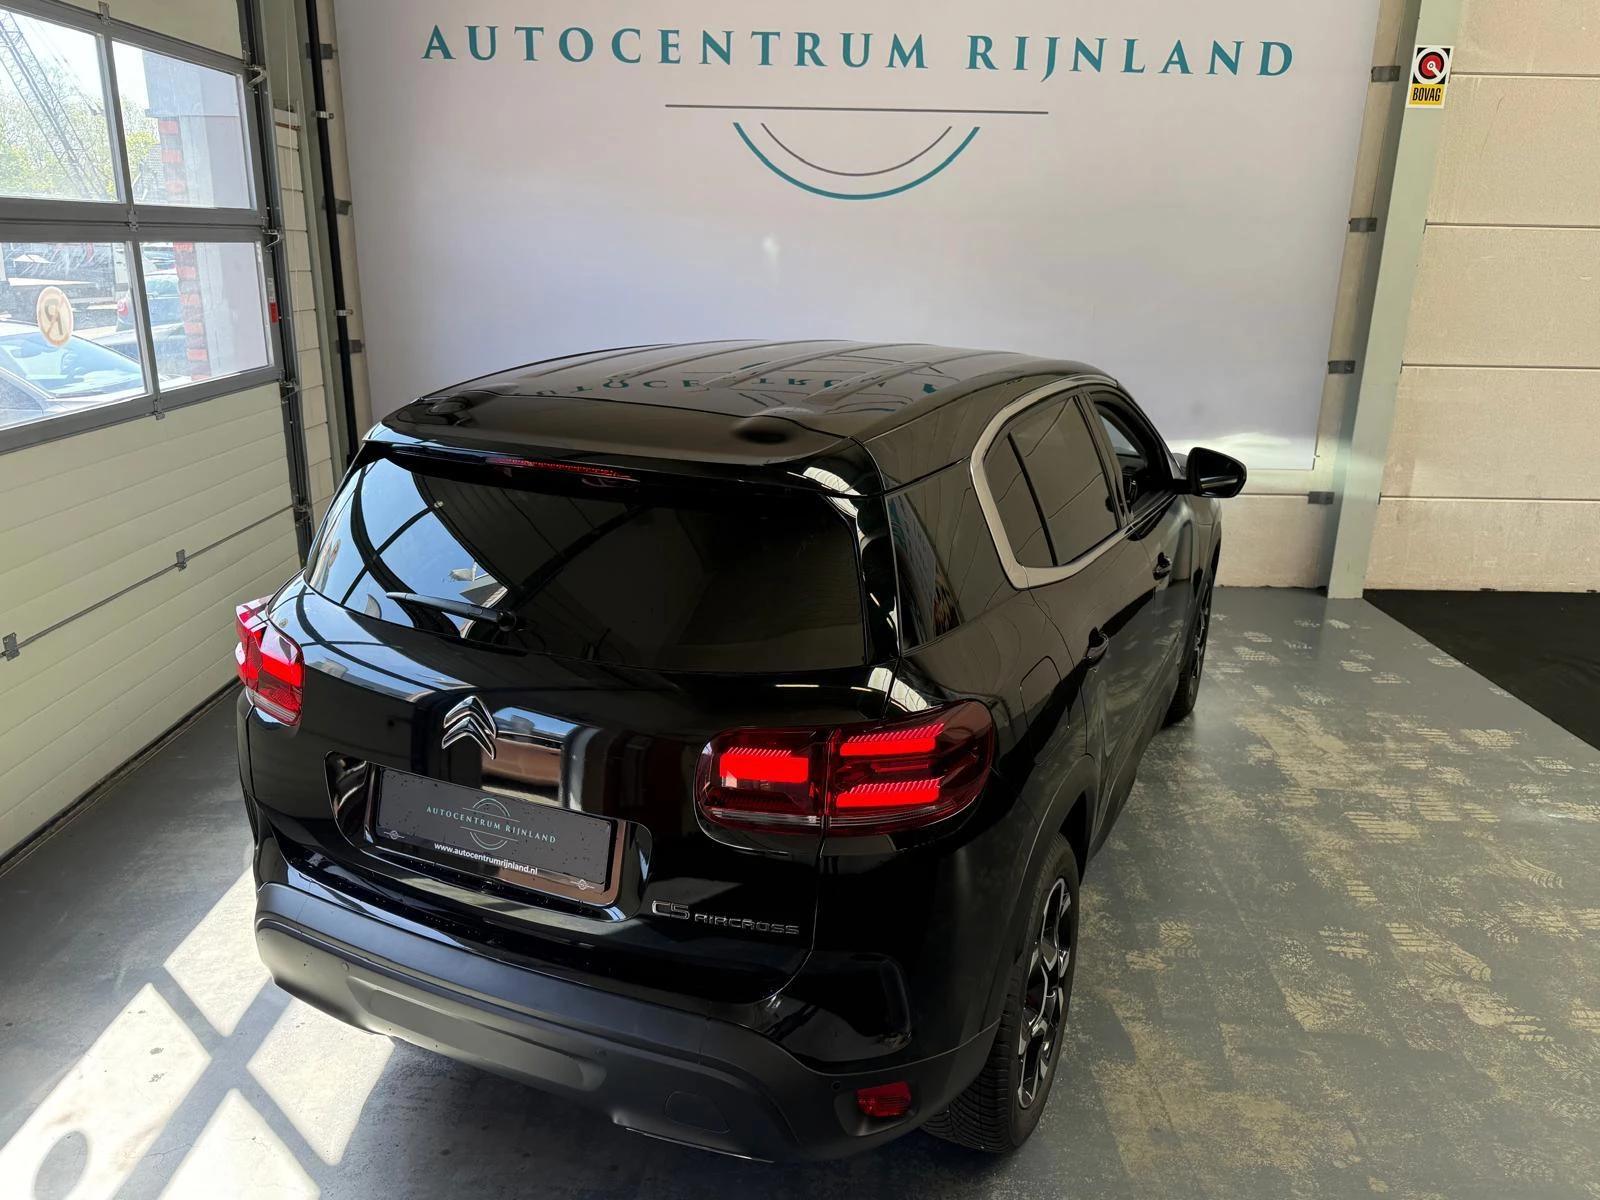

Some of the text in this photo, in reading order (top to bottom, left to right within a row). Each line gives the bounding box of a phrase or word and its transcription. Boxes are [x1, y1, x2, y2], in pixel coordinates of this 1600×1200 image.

[421, 24, 1294, 82] AUTOCENTRUM RIJNLAND
[1412, 87, 1441, 102] BOVAG
[426, 805, 557, 845] AUTOCENTRUM RIJNLAND
[433, 842, 539, 875] www.autocentrumrijnland.nl
[651, 900, 800, 935] C5 AIRCROSS
